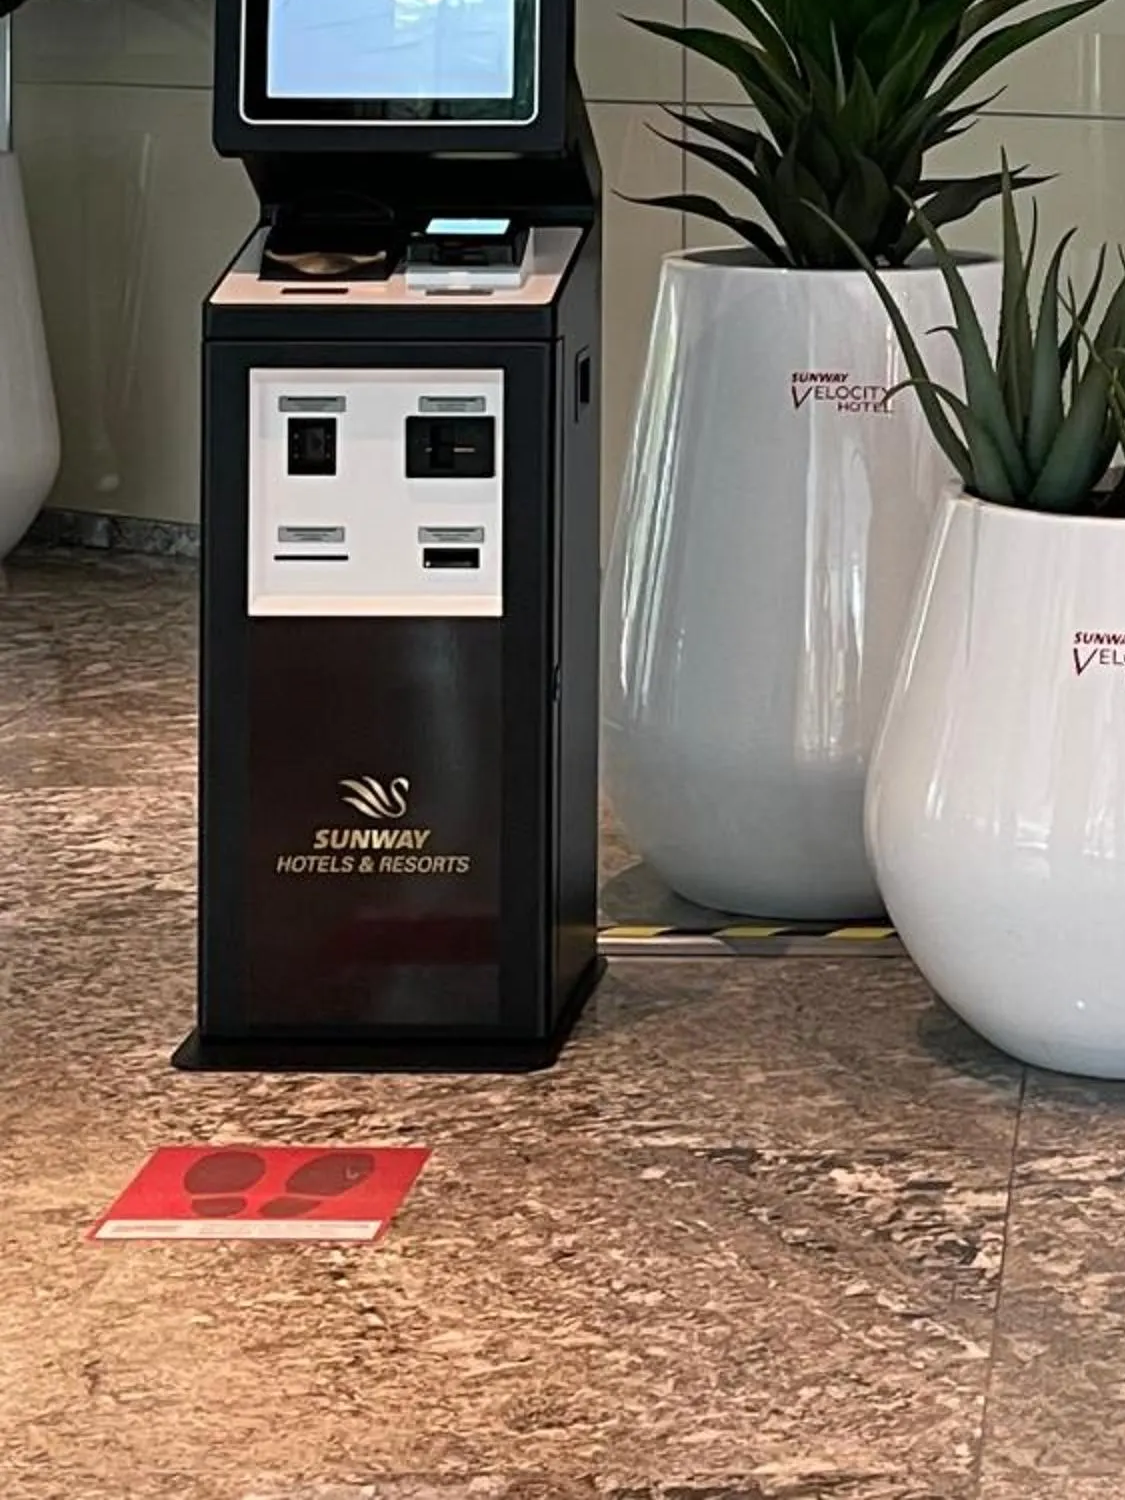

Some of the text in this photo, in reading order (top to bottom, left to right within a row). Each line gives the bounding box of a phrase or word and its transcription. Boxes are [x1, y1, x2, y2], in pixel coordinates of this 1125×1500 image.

[791, 371, 849, 384] SUNWAY
[313, 828, 431, 850] SUNWAY
[276, 855, 471, 874] HOTELS & RESORTS
